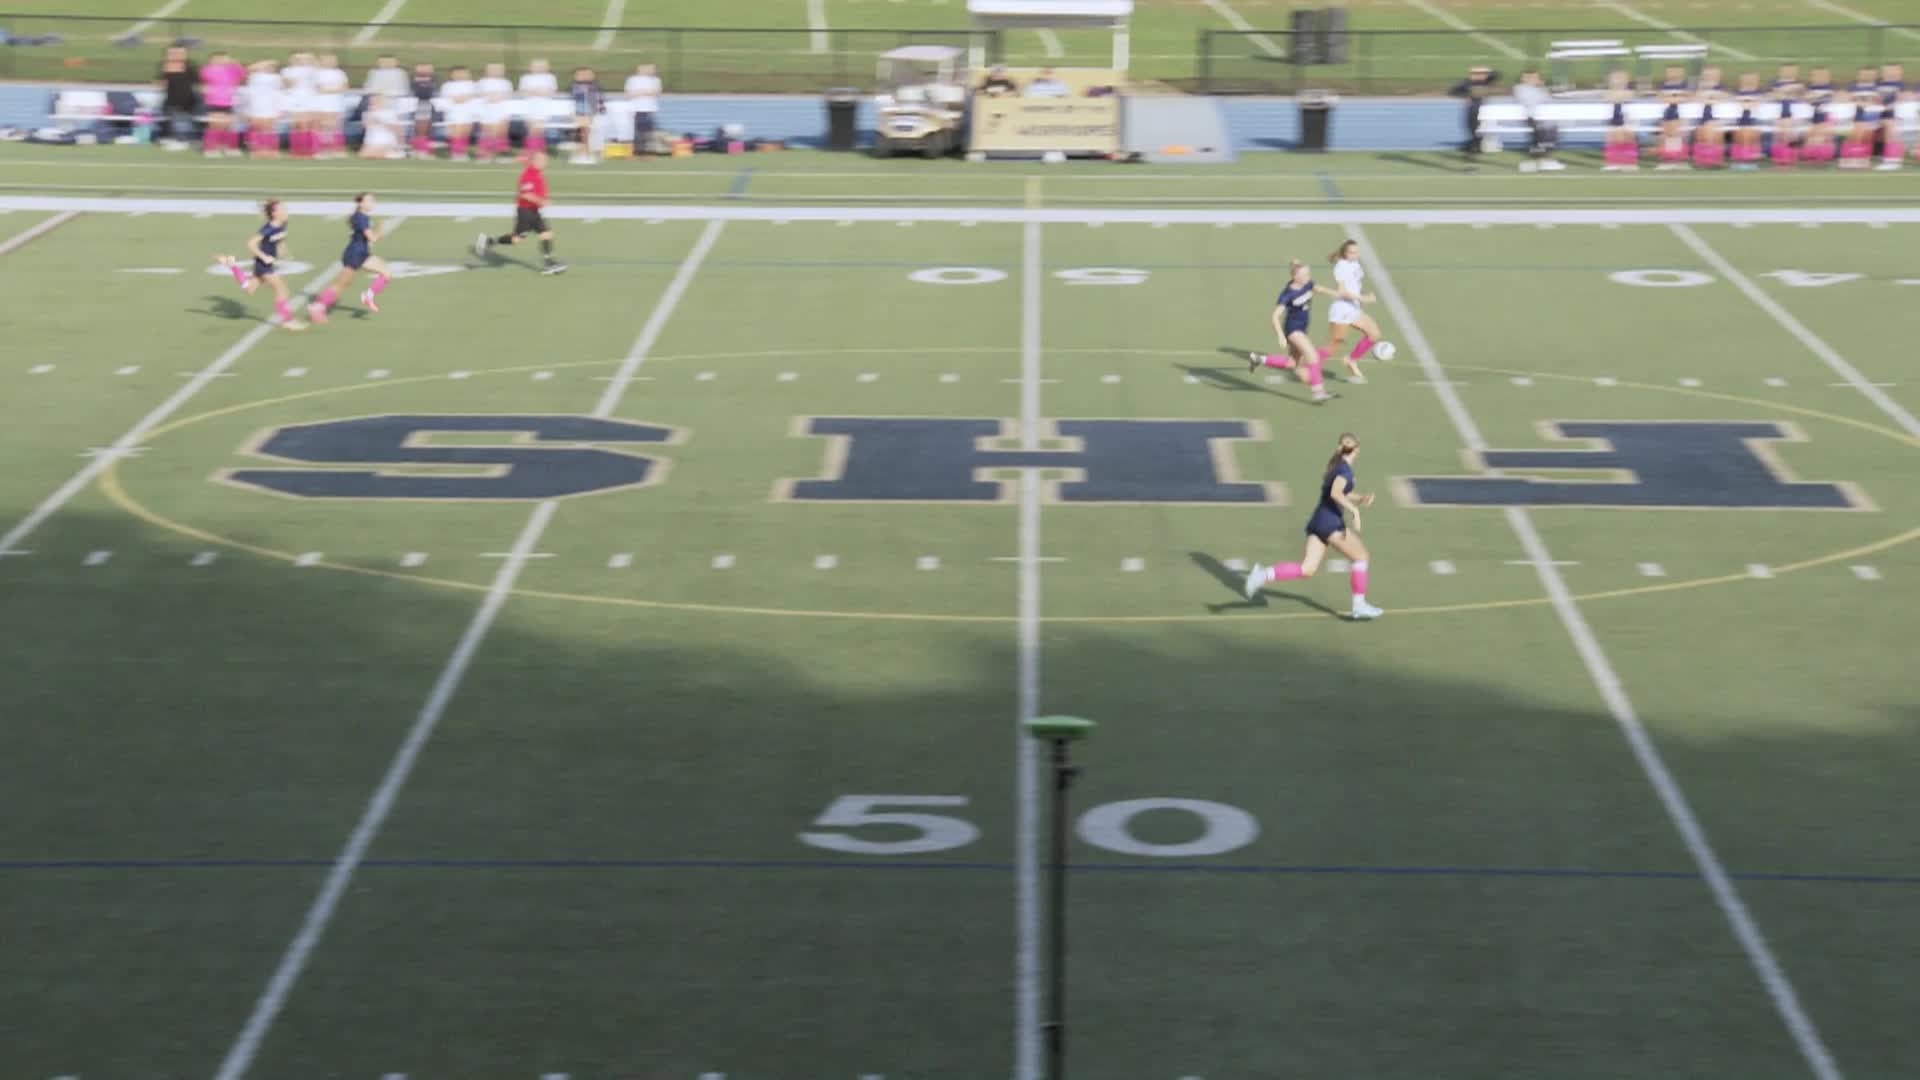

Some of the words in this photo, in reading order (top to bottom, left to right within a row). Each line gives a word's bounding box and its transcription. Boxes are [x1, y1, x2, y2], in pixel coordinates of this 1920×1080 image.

[907, 266, 1150, 286] 50
[1607, 269, 1865, 288] 40
[212, 414, 1876, 510] FHS
[798, 794, 1261, 857] 50
